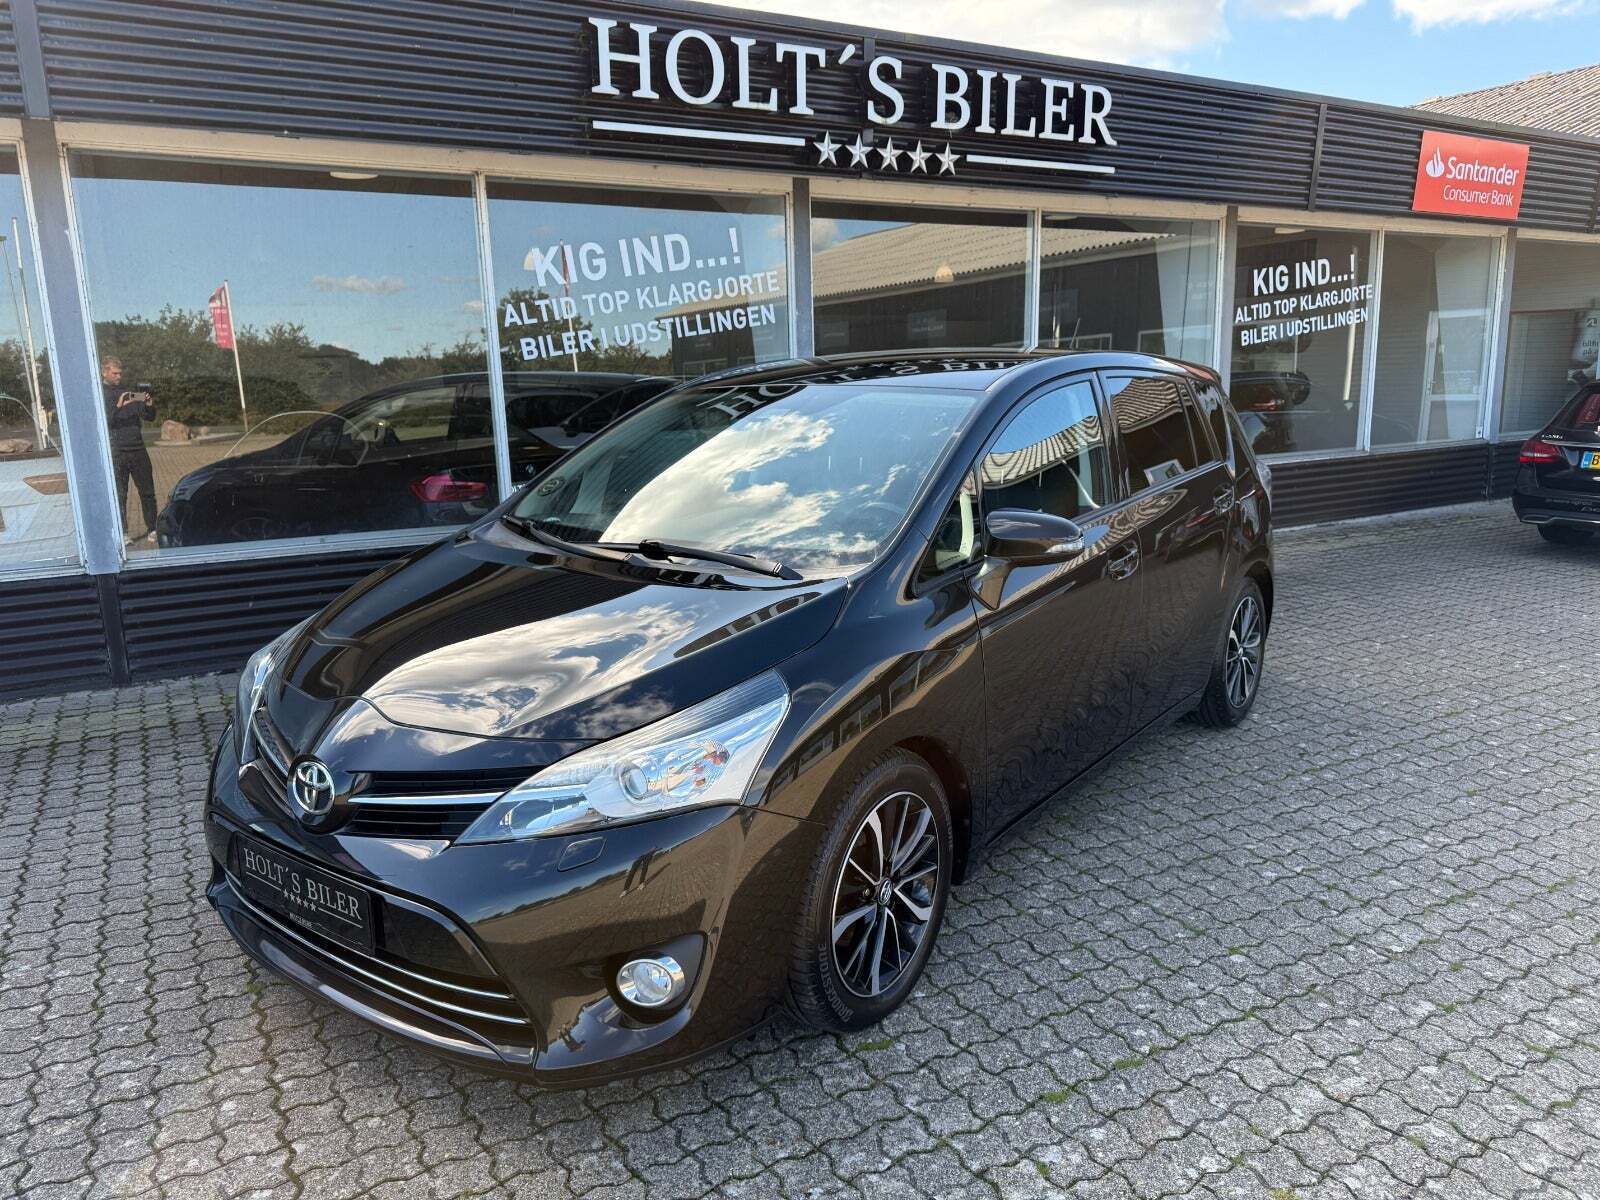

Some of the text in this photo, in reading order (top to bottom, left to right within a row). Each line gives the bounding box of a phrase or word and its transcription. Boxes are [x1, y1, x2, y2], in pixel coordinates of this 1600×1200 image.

[930, 63, 1118, 146] BILER
[1446, 156, 1519, 186] Santander
[1443, 185, 1513, 207] Consumer Bank
[531, 227, 741, 287] KIG IND...!
[1253, 254, 1355, 296] KIG IND...!
[504, 270, 780, 328] ALTID TOP KLARGJORTE
[1235, 284, 1373, 324] ALTID TOP KLARGJORTE
[520, 303, 775, 361] BILER I UDSTILLINGEN
[1241, 307, 1368, 346] BILER I UDSTILLINGEN
[305, 878, 362, 920] BILER
